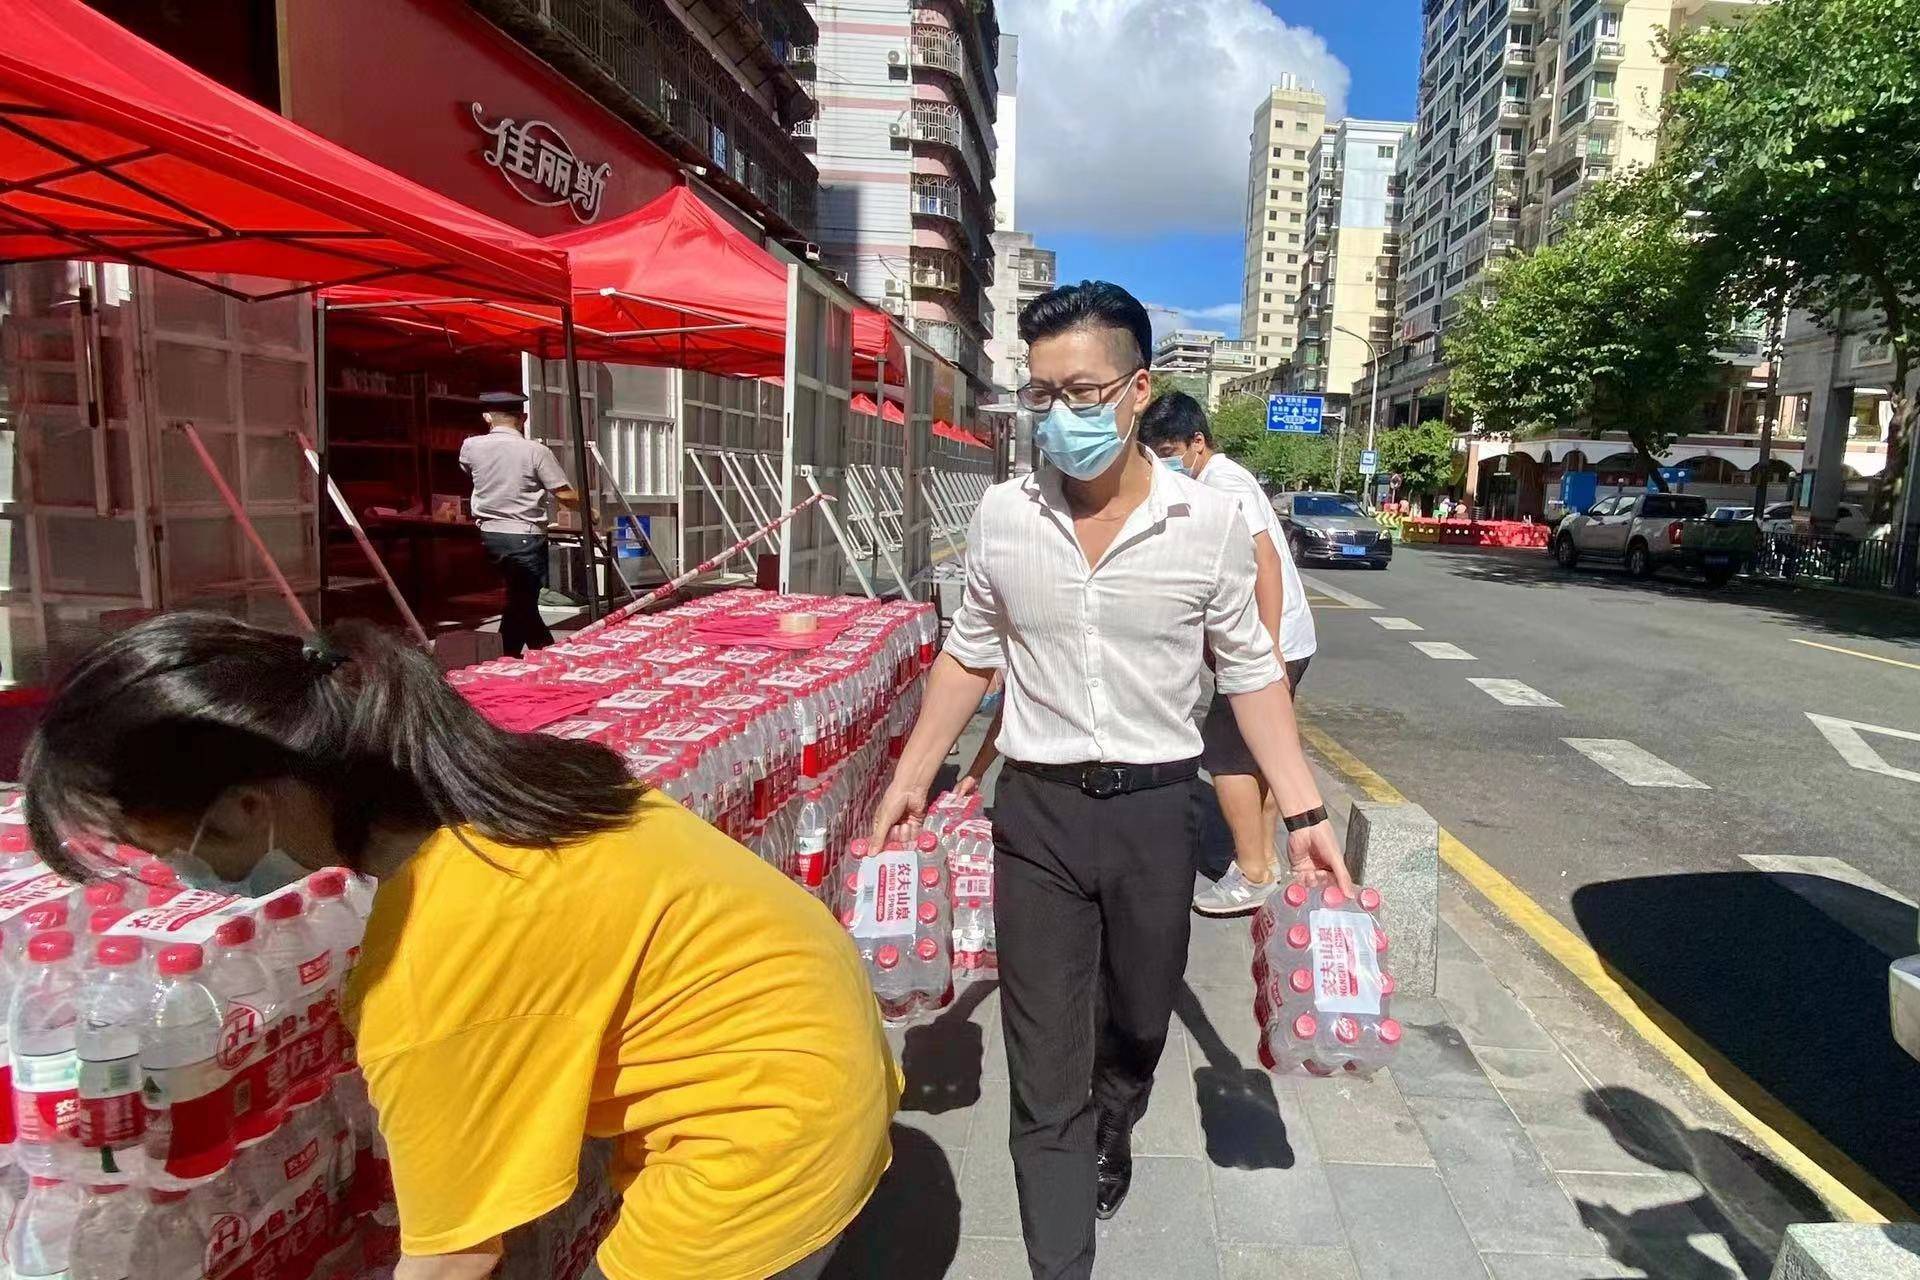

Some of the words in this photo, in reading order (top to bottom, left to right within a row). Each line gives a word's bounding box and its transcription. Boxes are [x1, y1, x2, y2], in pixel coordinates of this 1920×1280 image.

[896, 863, 912, 920] 农夫山泉
[1319, 927, 1336, 996] 农夫山泉
